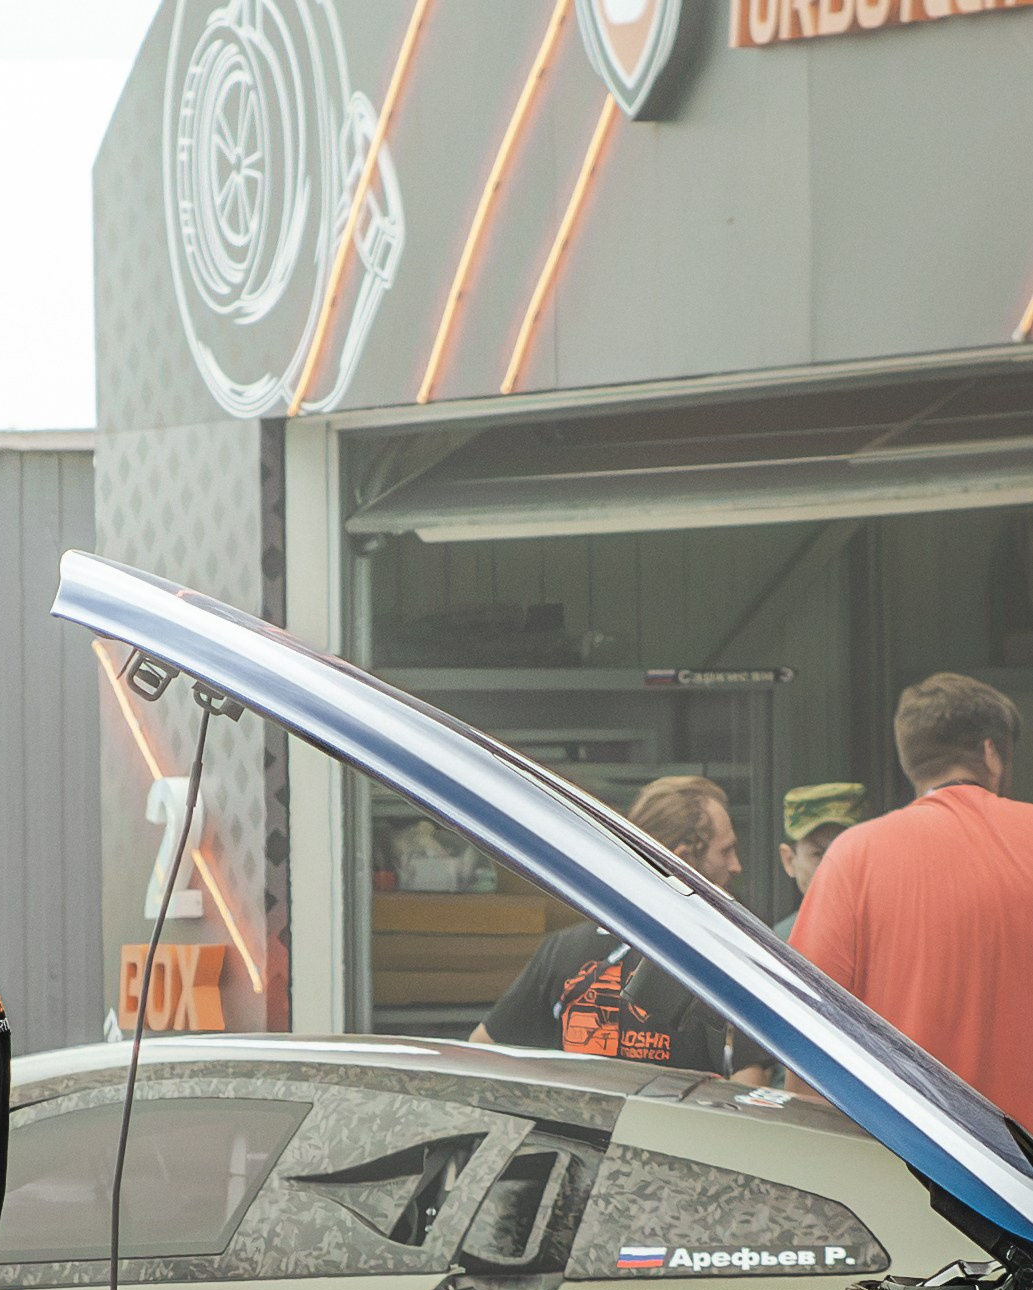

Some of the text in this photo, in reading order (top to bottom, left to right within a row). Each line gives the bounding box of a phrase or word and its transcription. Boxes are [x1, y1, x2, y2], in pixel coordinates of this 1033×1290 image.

[144, 776, 205, 919] 2
[118, 943, 208, 1031] BOX
[668, 1246, 856, 1271] Арефьев Р.
